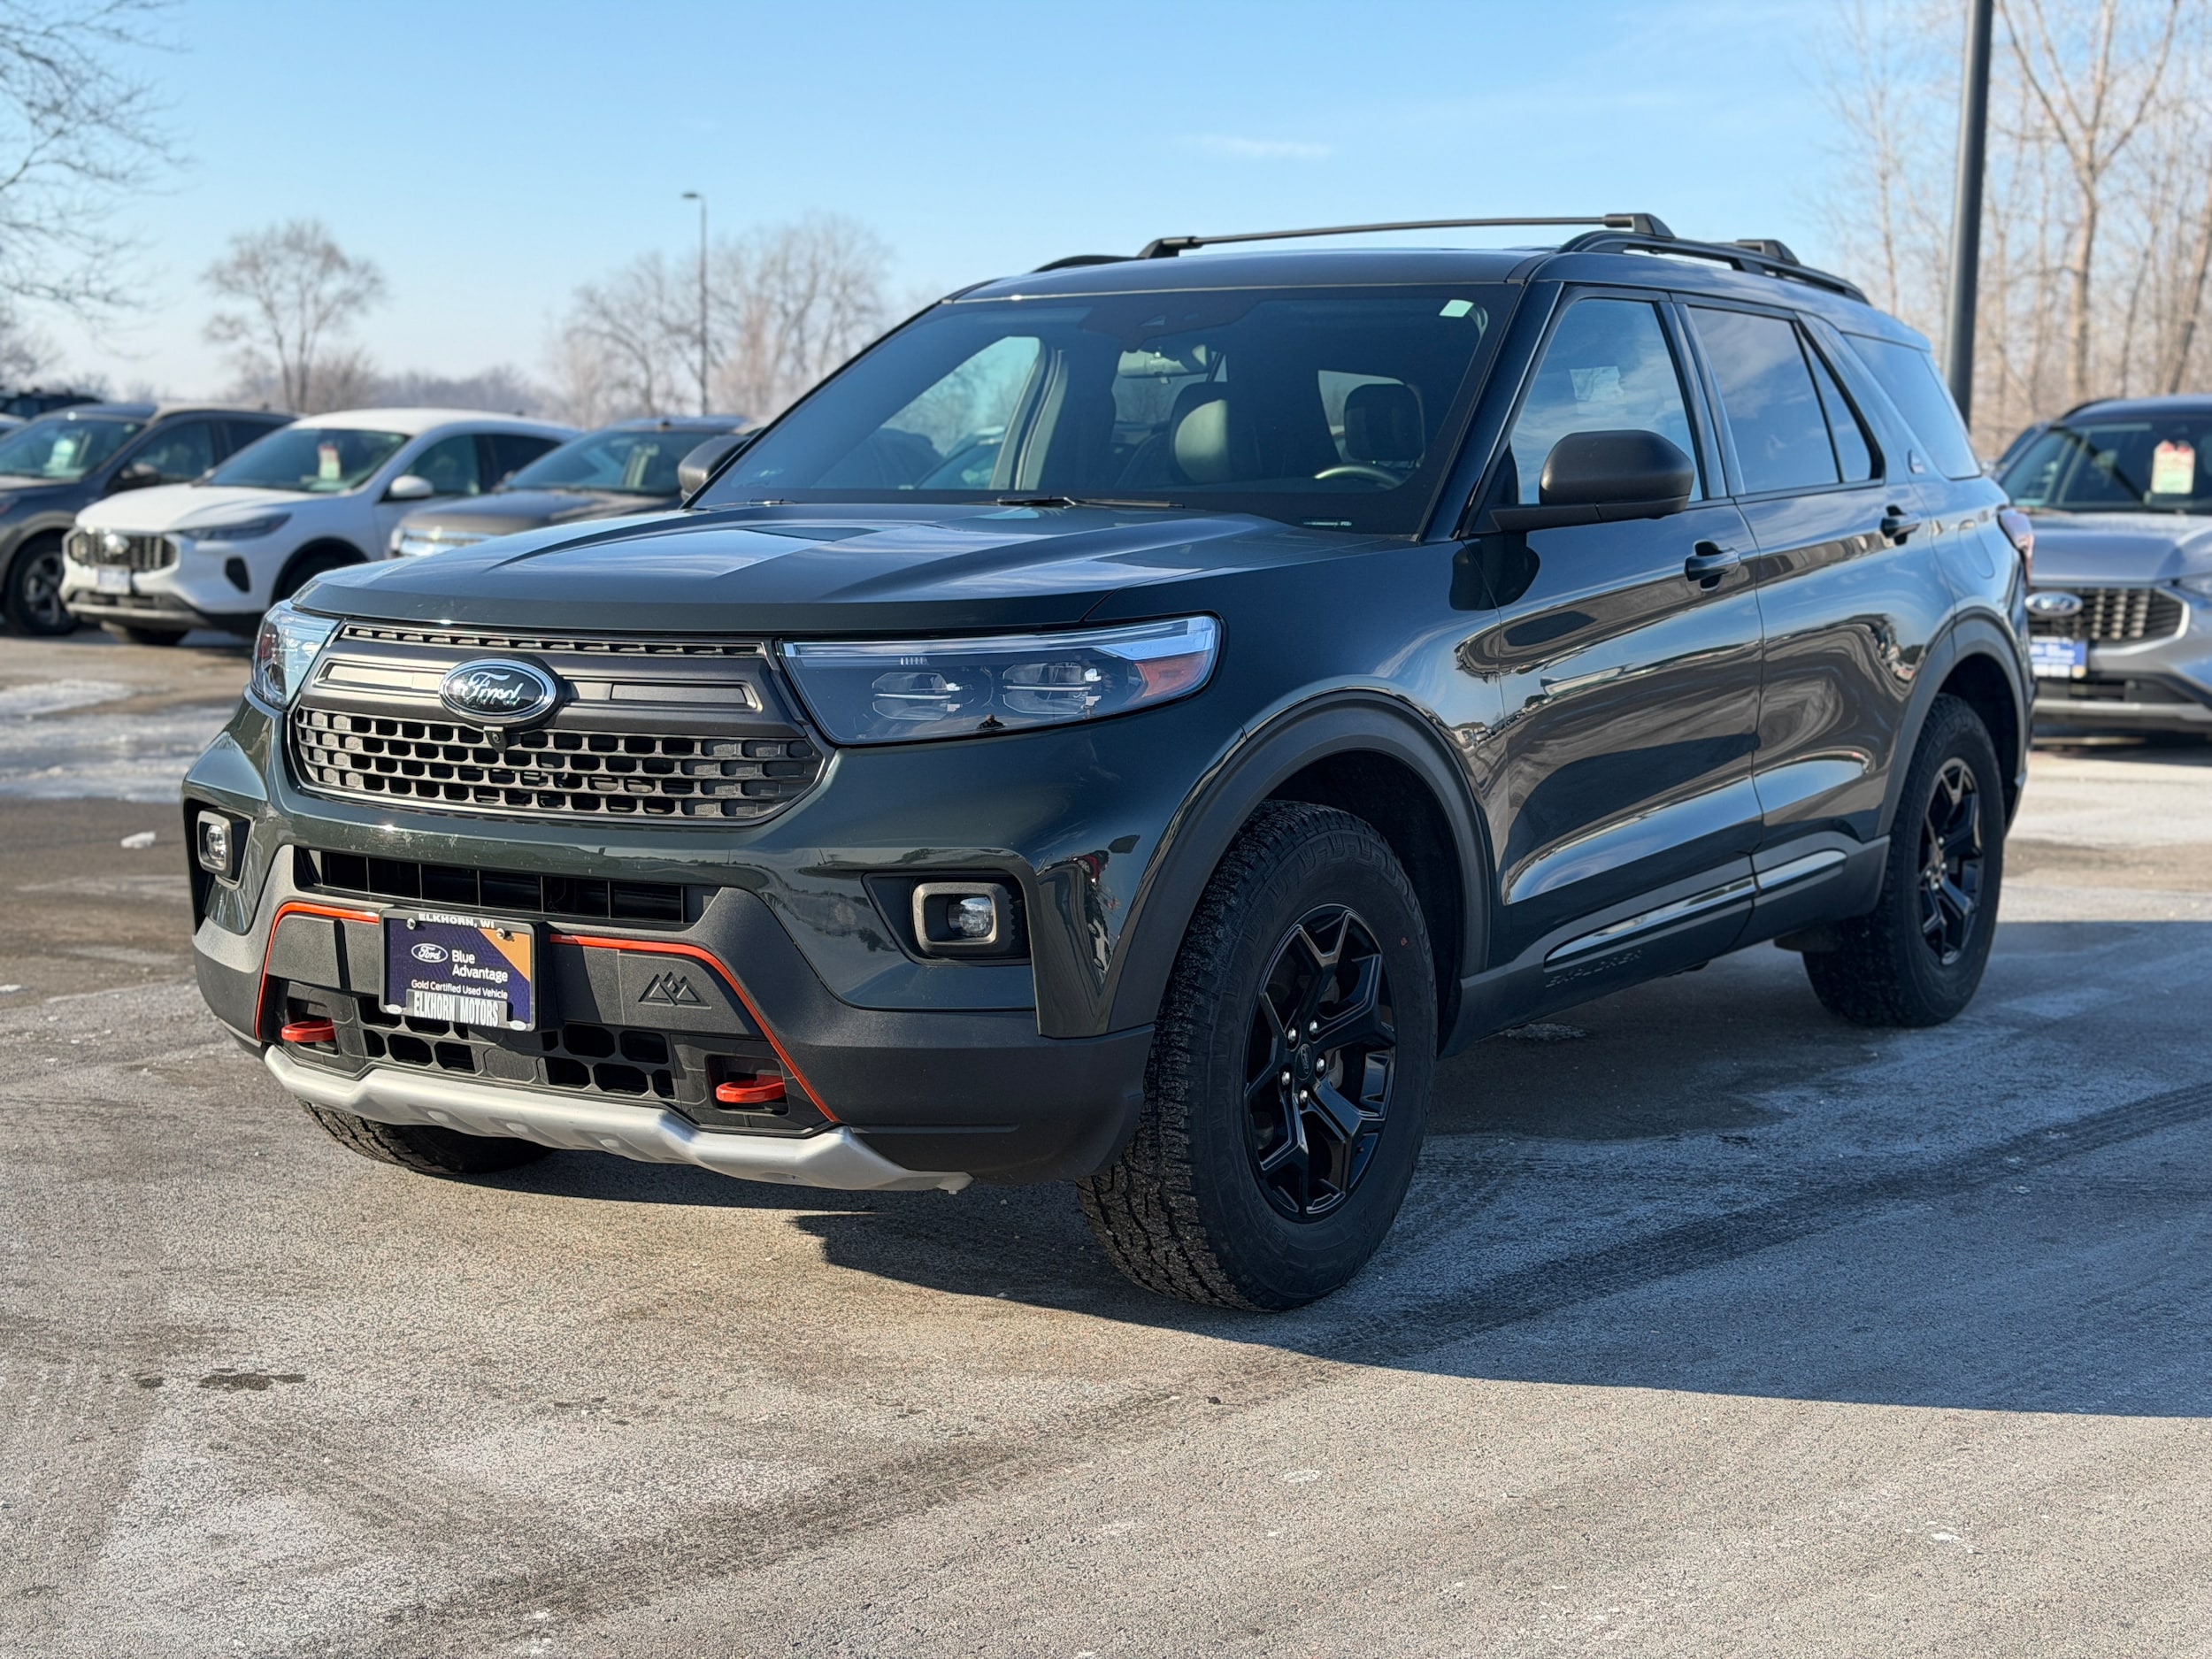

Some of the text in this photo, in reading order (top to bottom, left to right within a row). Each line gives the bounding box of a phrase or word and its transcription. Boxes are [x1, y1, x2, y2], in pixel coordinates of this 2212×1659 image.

[461, 671, 525, 706] Ford
[418, 913, 495, 929] ELKHORN, WI
[418, 945, 442, 960] Ford
[451, 949, 476, 964] Blue
[451, 964, 509, 984] Advantage
[411, 979, 509, 1000] Gold Certified Used Vehicle
[413, 990, 500, 1027] ELKHORN MOTORS
